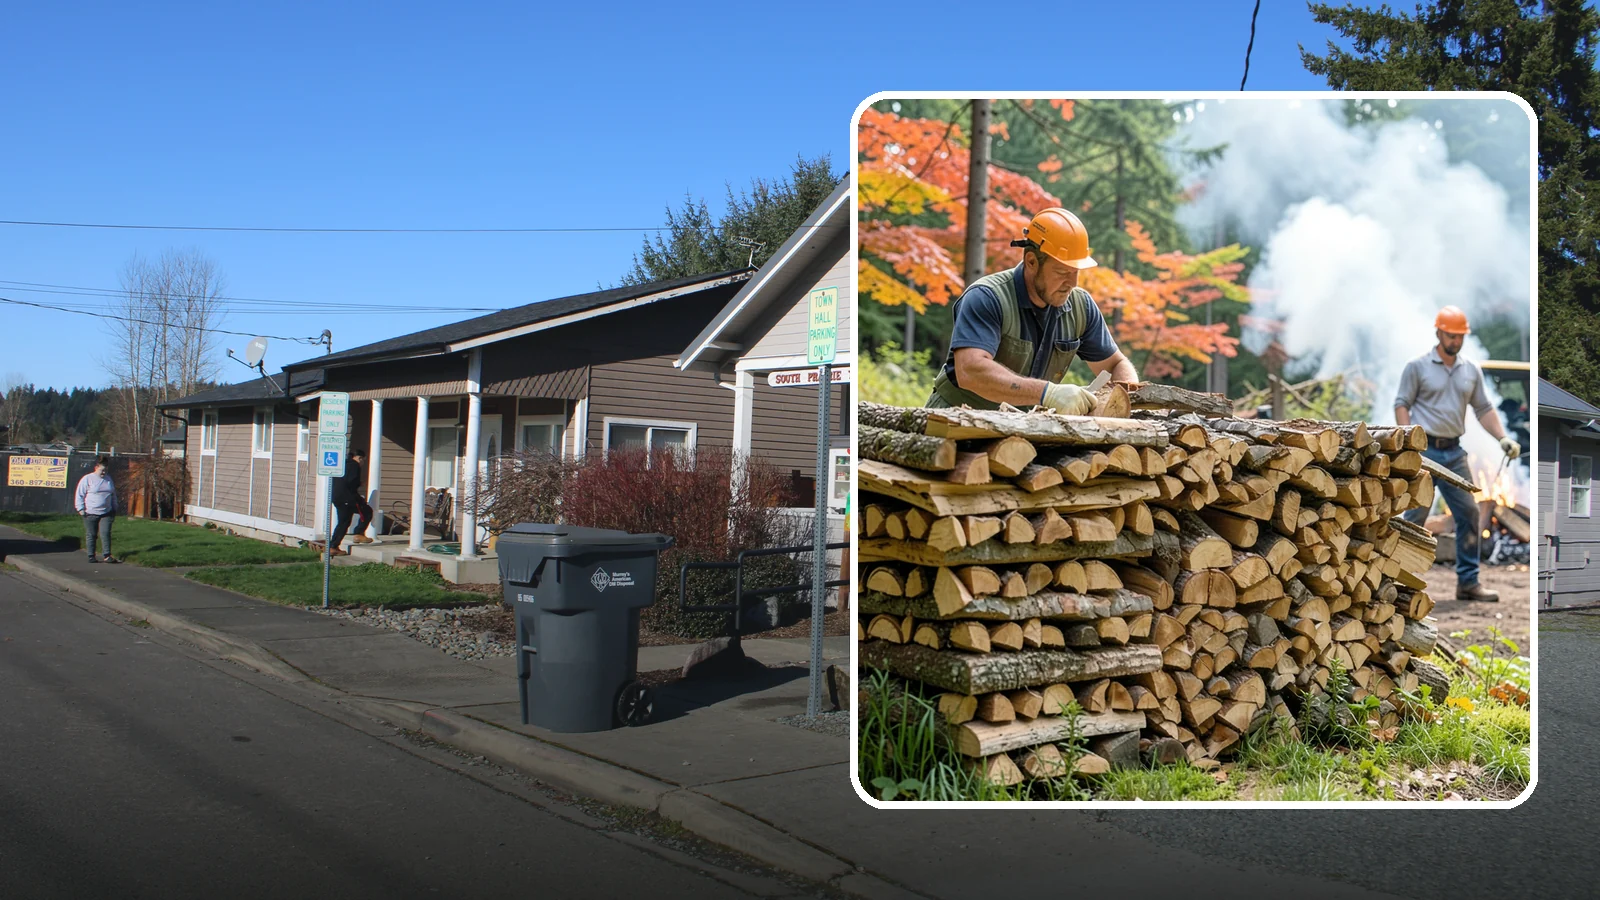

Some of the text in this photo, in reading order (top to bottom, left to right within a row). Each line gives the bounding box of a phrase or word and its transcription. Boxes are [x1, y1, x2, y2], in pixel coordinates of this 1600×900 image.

[815, 294, 833, 308] TOWN
[814, 311, 831, 325] HALL
[810, 326, 836, 341] PARKING
[814, 344, 830, 357] ONLY
[775, 370, 842, 384] SOUTH PRIE
